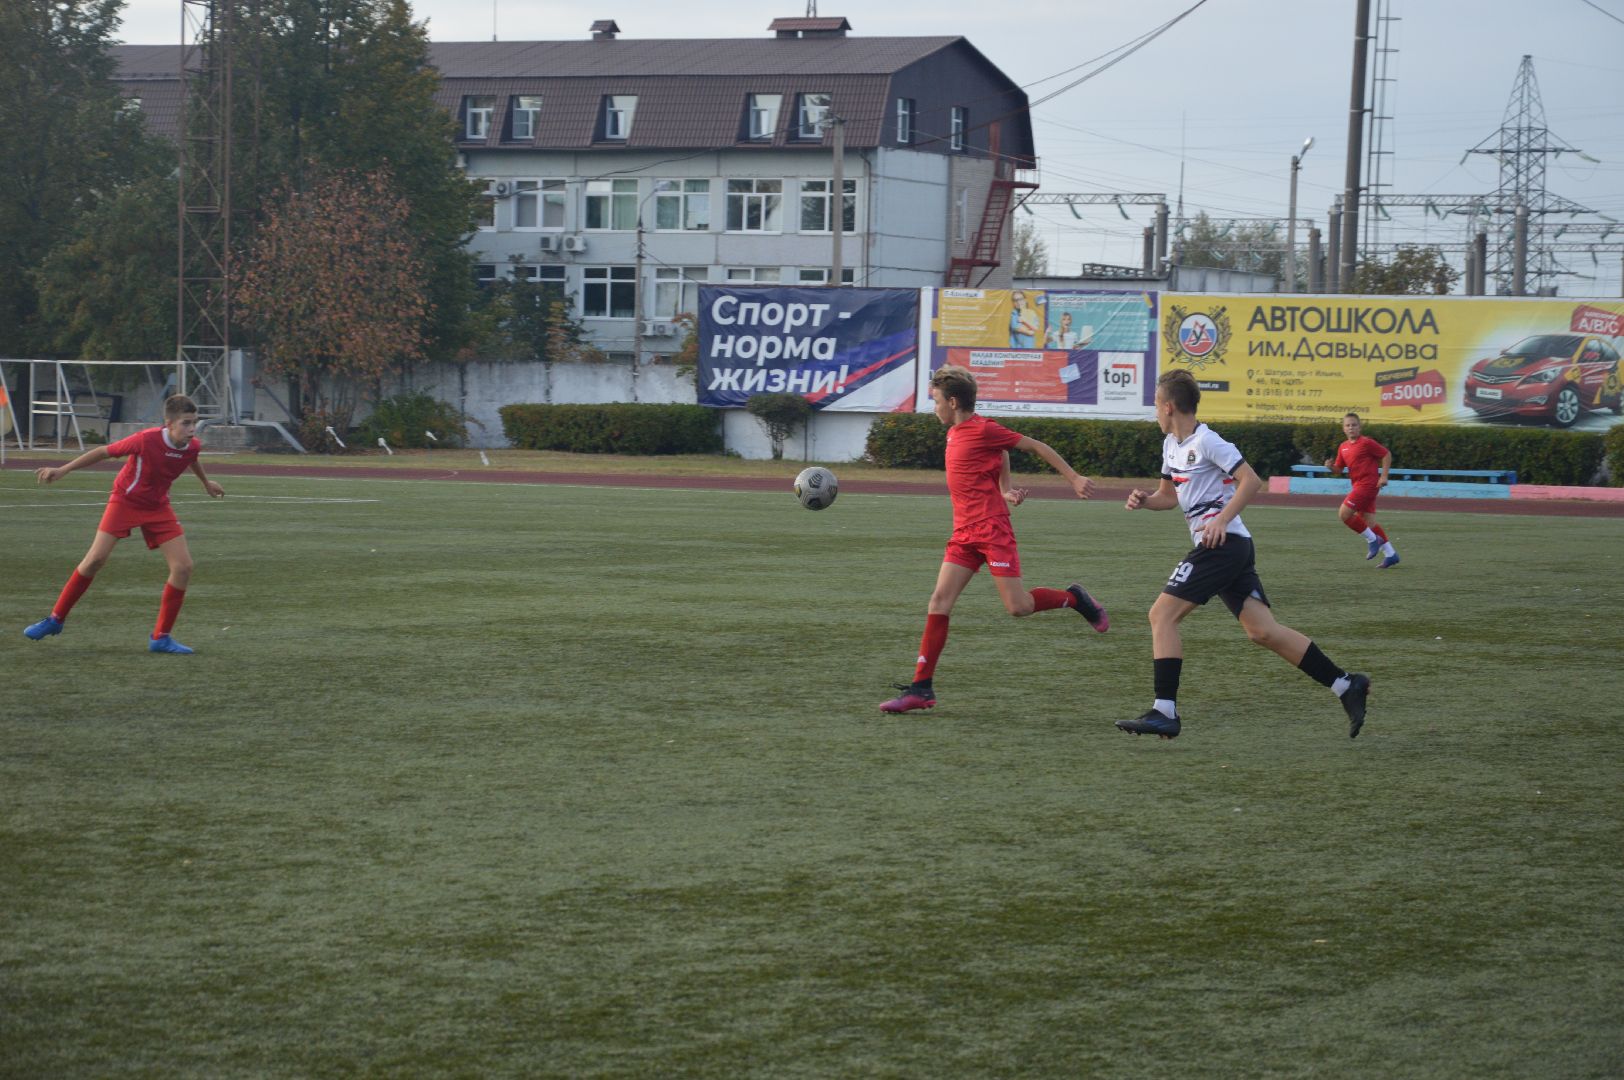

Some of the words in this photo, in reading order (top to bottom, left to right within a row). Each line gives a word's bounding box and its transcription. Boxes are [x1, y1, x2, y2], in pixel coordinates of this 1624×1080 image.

[711, 295, 830, 333] Спорт
[1246, 306, 1440, 335] АВТОШКОЛА
[710, 334, 837, 366] норма
[1248, 337, 1438, 362] им.Давыдова
[707, 364, 849, 394] жизни!
[1104, 369, 1131, 387] top
[1382, 391, 1393, 400] от
[1394, 383, 1433, 400] 5000
